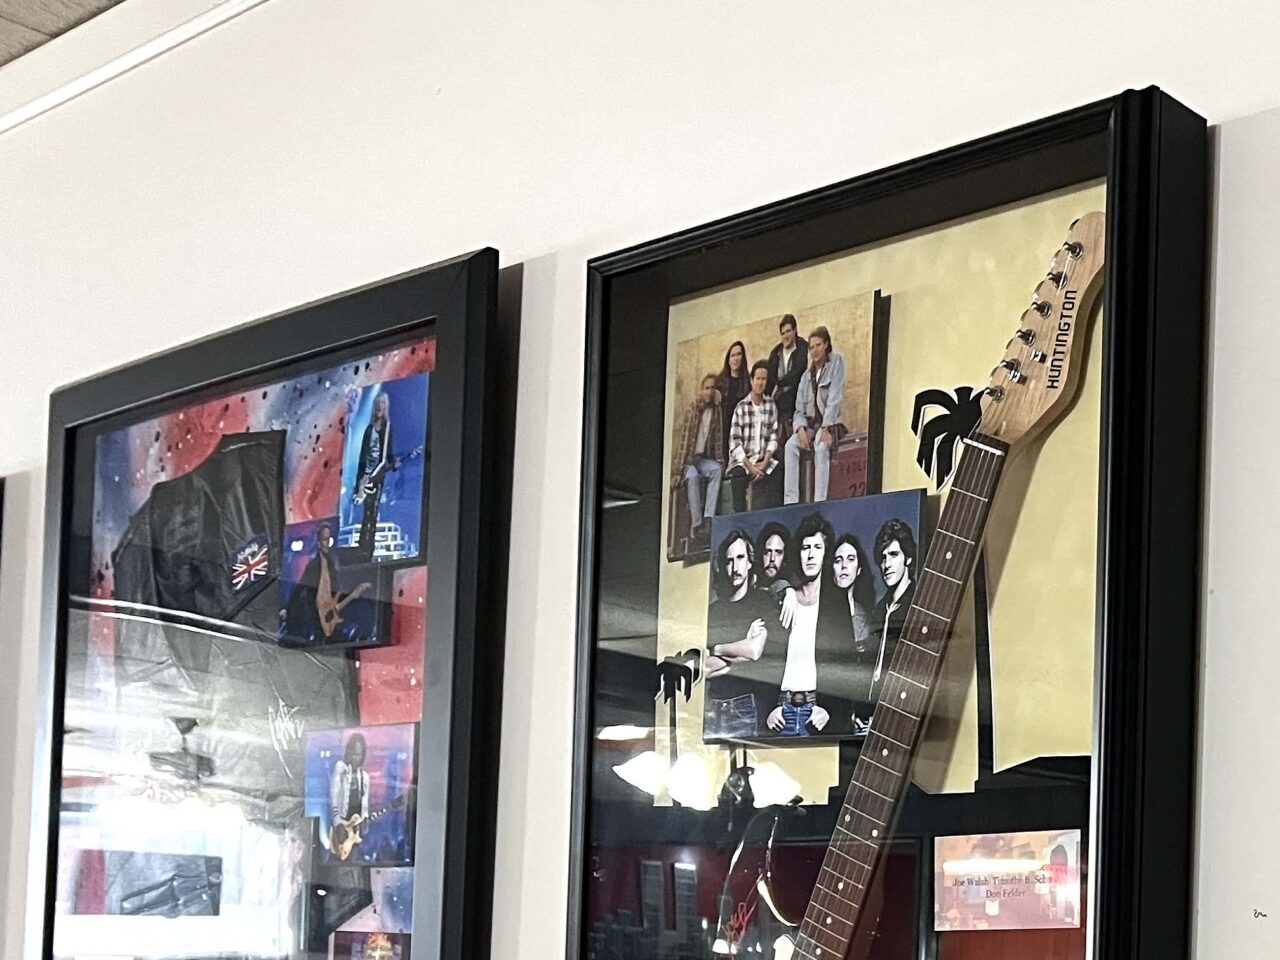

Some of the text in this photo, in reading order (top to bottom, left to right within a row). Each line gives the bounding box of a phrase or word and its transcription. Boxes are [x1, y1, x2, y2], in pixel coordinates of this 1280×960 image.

[1046, 290, 1077, 389] HUNTINGTON
[952, 878, 966, 887] Joe
[967, 877, 989, 887] Walsh
[986, 889, 1026, 899] Don Felder
